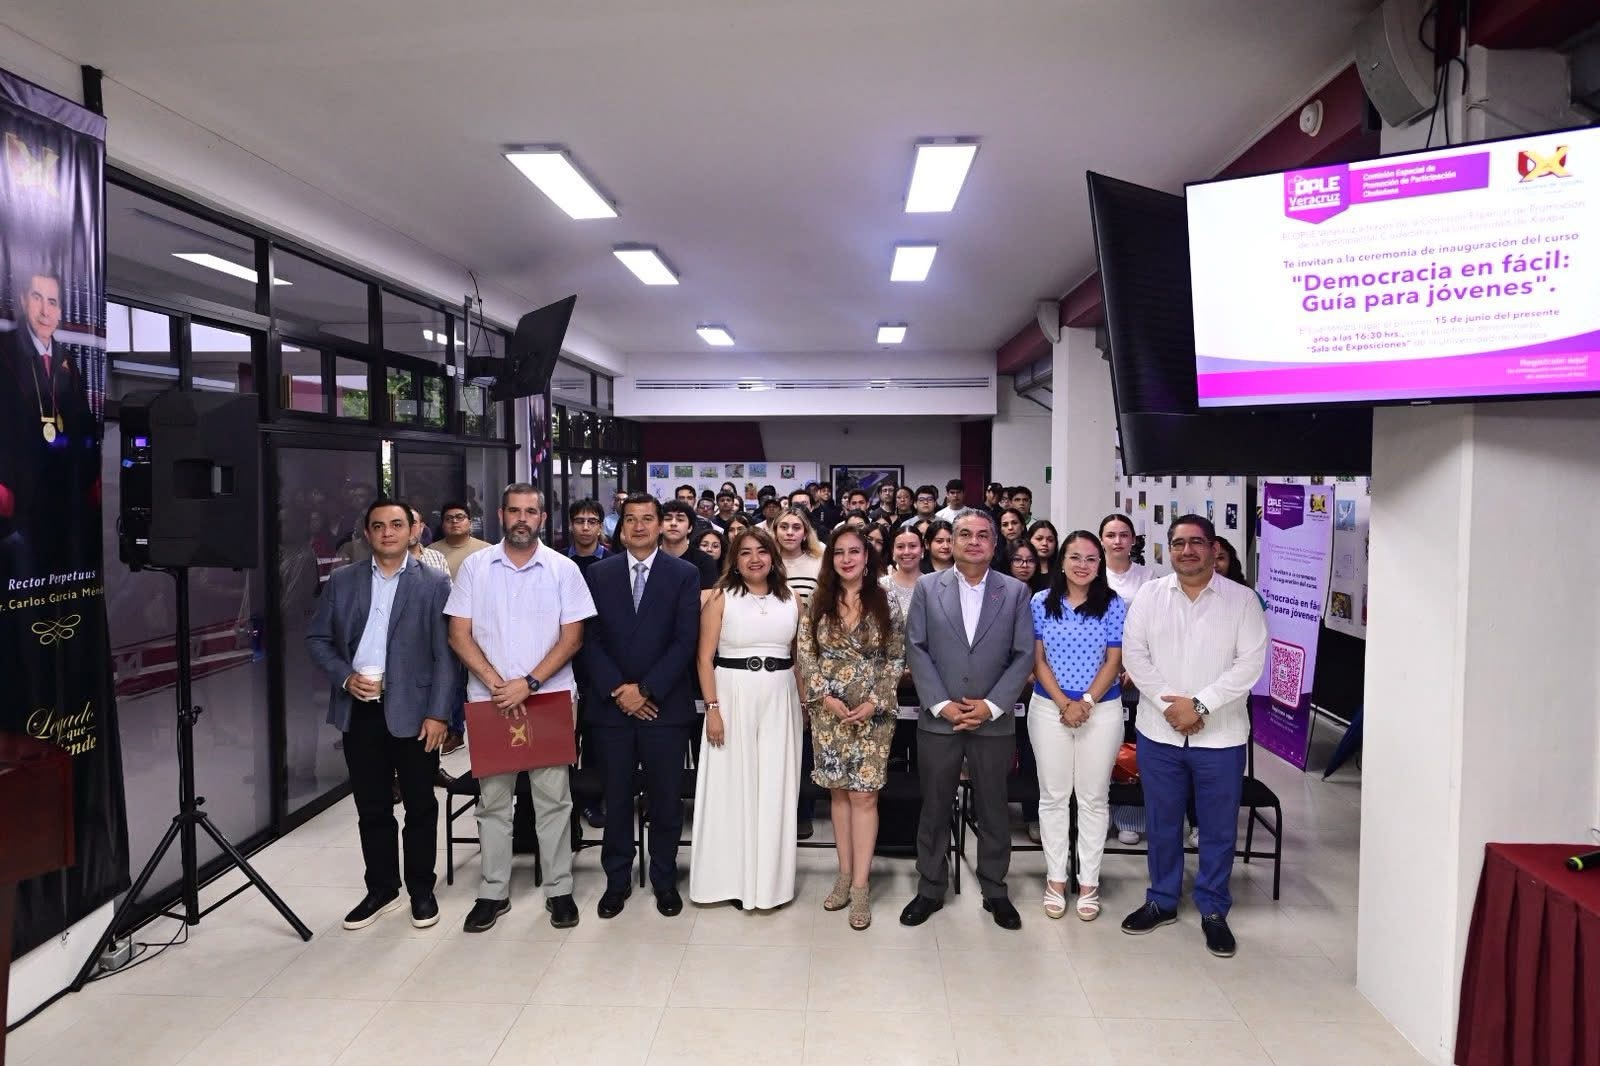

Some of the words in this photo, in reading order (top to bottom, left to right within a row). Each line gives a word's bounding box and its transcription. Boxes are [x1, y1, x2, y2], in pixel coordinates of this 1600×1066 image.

[1288, 192, 1340, 207] Veracruz
[1284, 260, 1295, 269] Te
[1298, 256, 1334, 268] invitan
[1345, 254, 1355, 263] la
[1358, 248, 1417, 262] ceremonia
[1420, 246, 1435, 256] de
[1438, 237, 1517, 253] inauguración
[1521, 234, 1541, 245] del
[1545, 232, 1579, 243] curso
[1292, 262, 1451, 291] "Democracia
[1461, 261, 1493, 277] en
[1501, 250, 1570, 274] fácil:
[1302, 292, 1356, 312] Guía
[1365, 290, 1419, 312] para
[1426, 275, 1556, 307] jóvenes".
[1435, 315, 1447, 325] 15
[1449, 314, 1463, 324] de
[1465, 312, 1492, 325] junio
[1494, 311, 1510, 321] del
[1512, 308, 1560, 322] presente
[1339, 332, 1353, 341] las
[1355, 331, 1382, 341] 16:30
[1331, 343, 1344, 352] de
[8, 577, 46, 591] Rector
[48, 570, 96, 585] Perpetuus
[8, 596, 46, 610] Carlos
[1274, 605, 1290, 615] para
[1300, 600, 1309, 609] en
[66, 726, 87, 742] que
